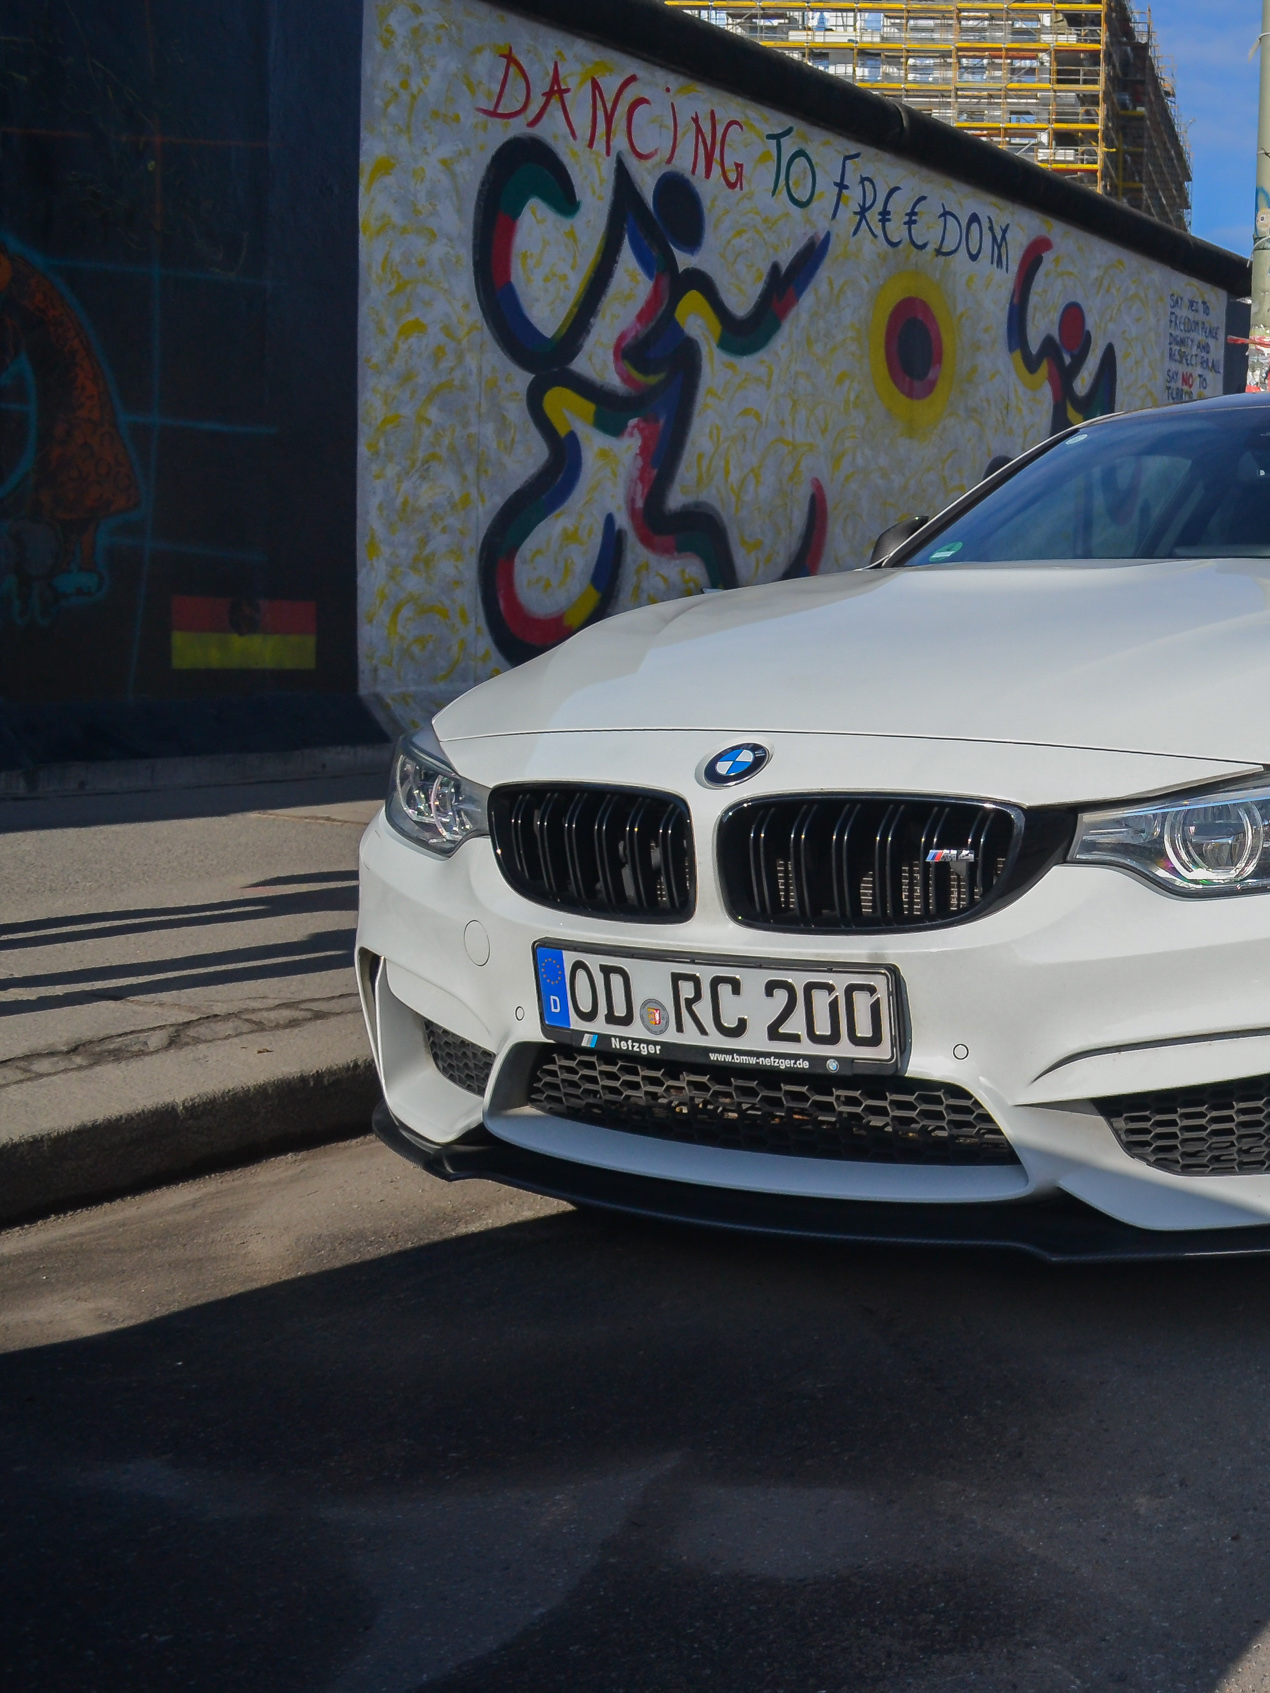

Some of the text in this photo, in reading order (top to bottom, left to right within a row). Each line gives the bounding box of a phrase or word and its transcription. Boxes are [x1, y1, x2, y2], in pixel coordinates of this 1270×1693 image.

[766, 126, 817, 208] TO
[1169, 293, 1210, 316] SAY YES TO
[1169, 311, 1220, 340] FREEDOM PEACE
[1168, 347, 1198, 366] RESPECT
[1196, 341, 1211, 354] AND
[1167, 369, 1208, 390] SAY NO TO
[550, 995, 560, 1014] D
[570, 959, 634, 1027] OD
[670, 971, 748, 1038] RC
[765, 978, 884, 1048] 200
[611, 1037, 661, 1055] Nefzger
[709, 1052, 810, 1069] www.bmw-nefzger.de
